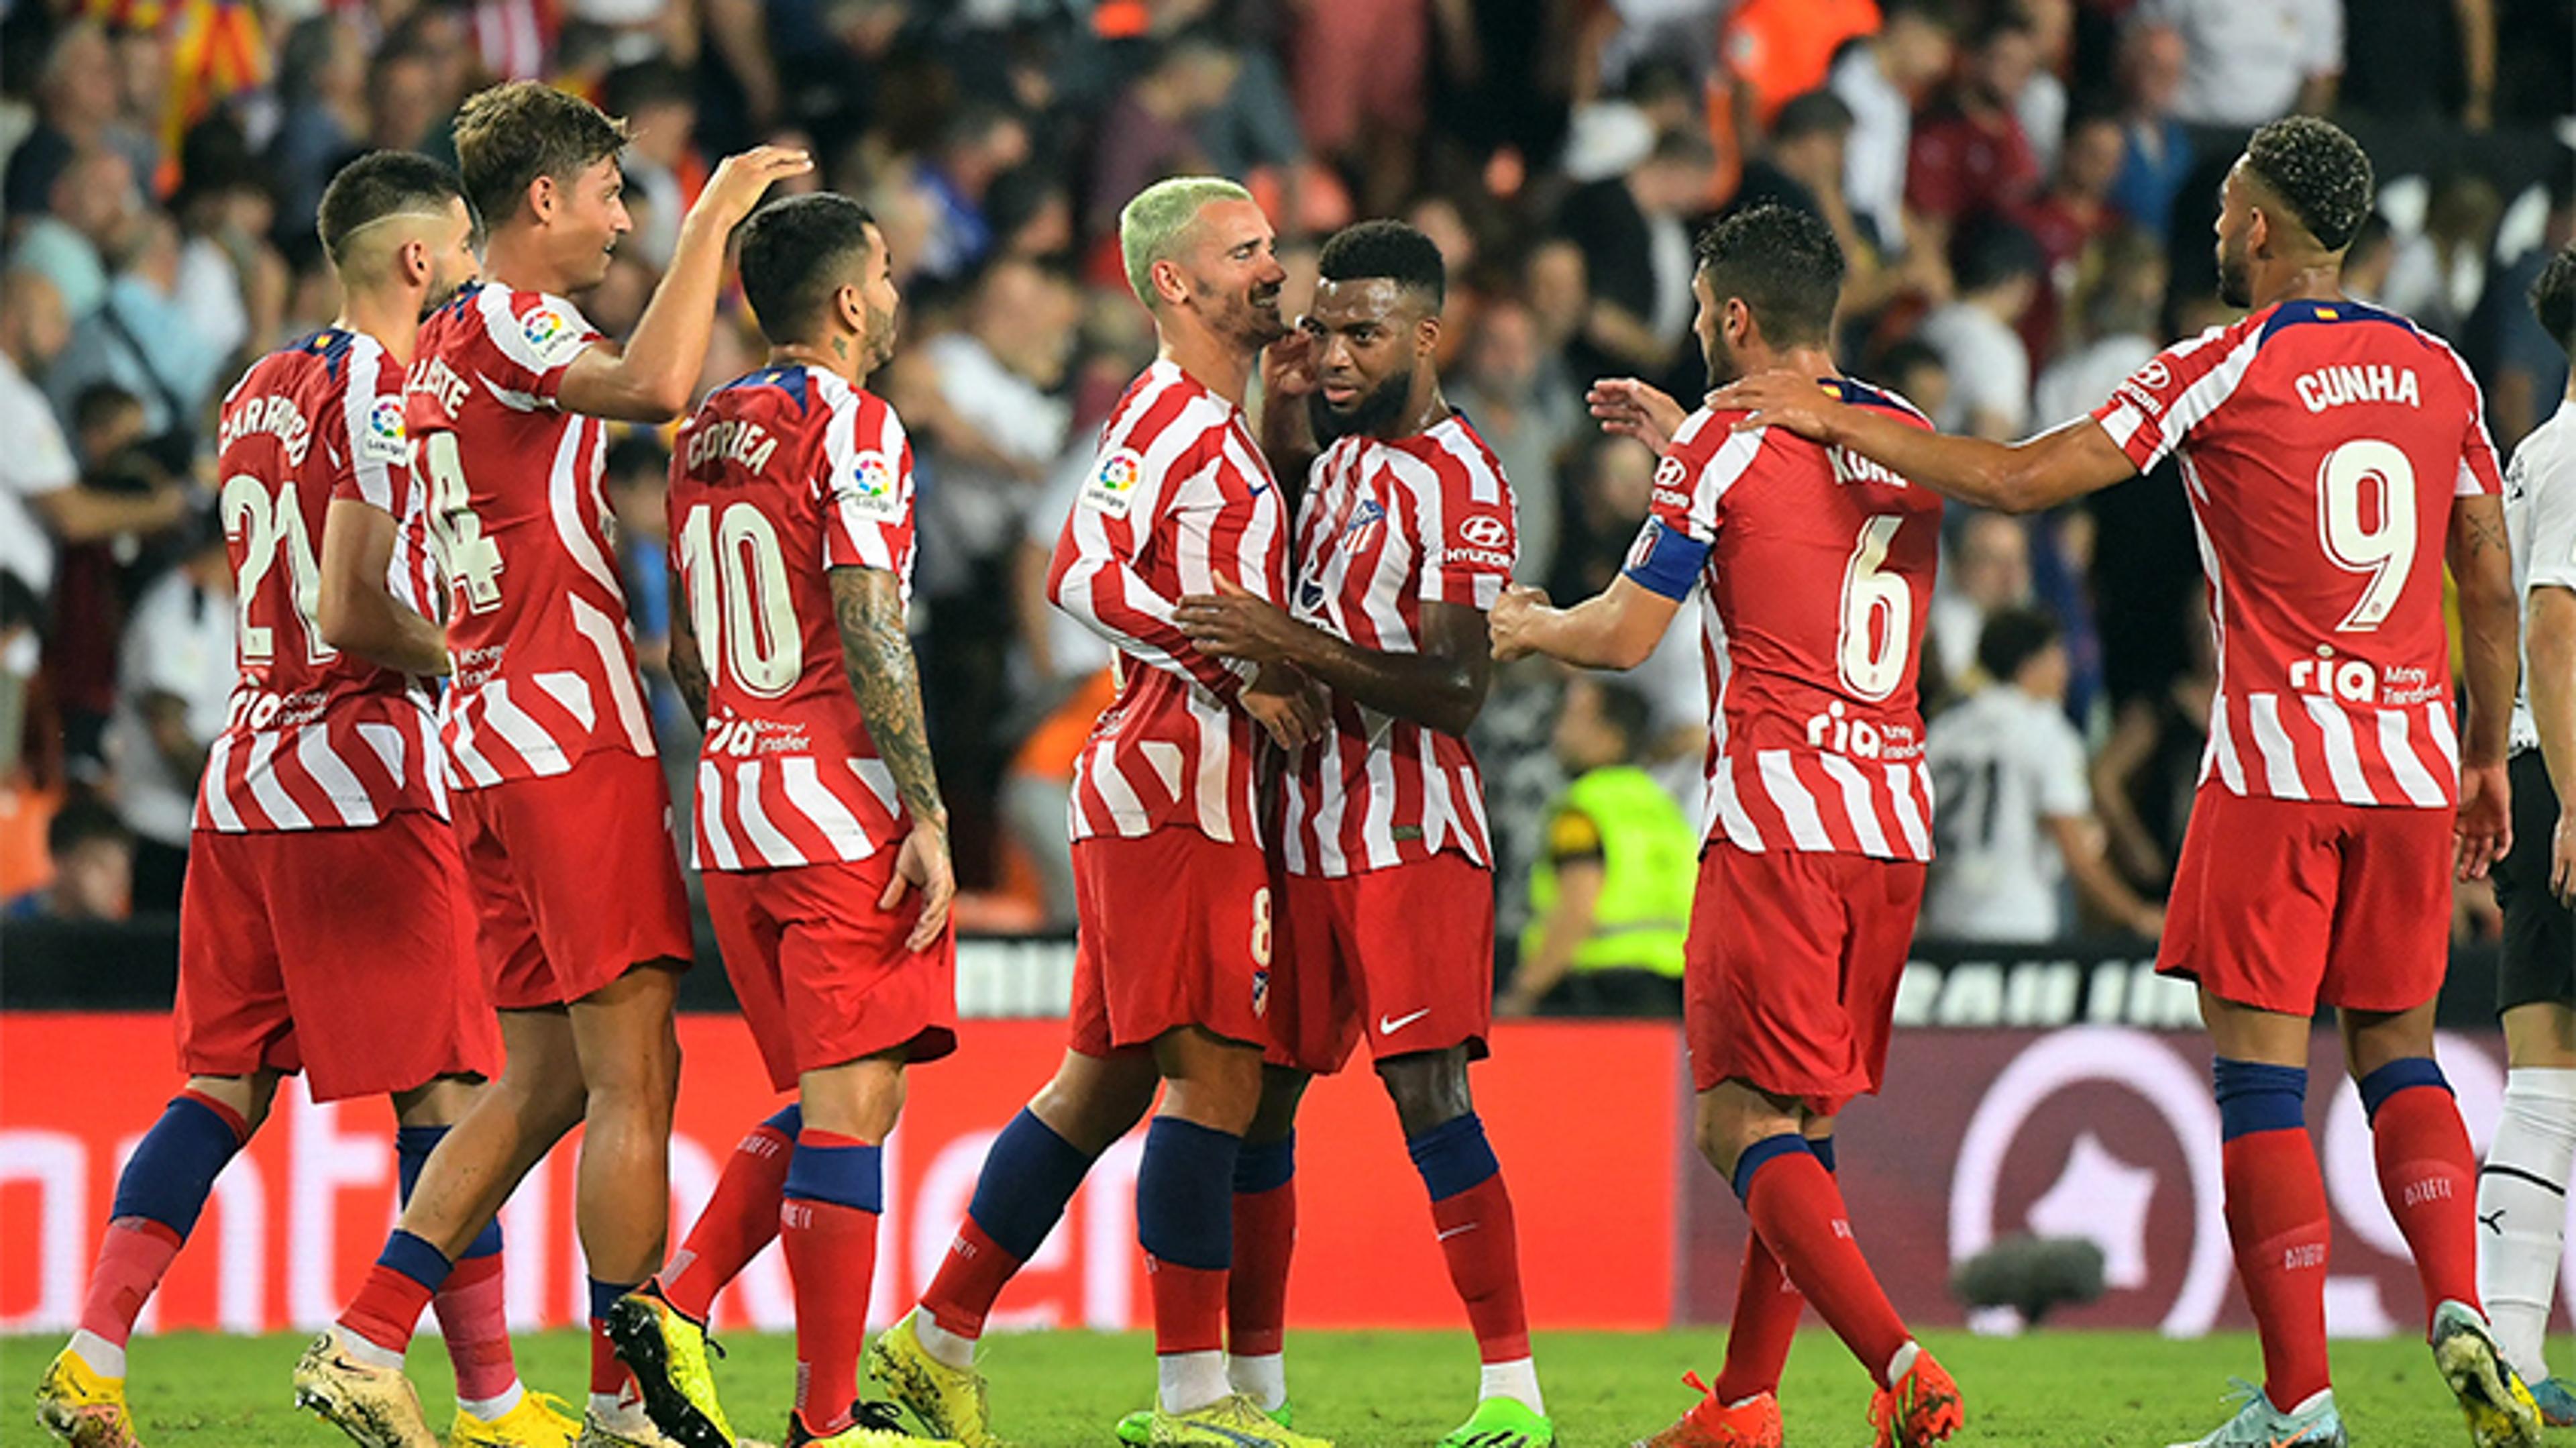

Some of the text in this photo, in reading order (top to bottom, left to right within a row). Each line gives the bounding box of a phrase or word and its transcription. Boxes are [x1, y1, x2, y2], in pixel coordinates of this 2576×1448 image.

[2295, 364, 2421, 413] CUNHA
[220, 474, 339, 666] 21
[1447, 548, 1512, 566] HYUNDAI
[2316, 439, 2417, 633] 9
[678, 502, 802, 699] 10
[1836, 515, 1912, 702] 6
[2289, 643, 2377, 703] ria
[1807, 700, 1880, 759] ria
[1251, 886, 1271, 967] 8
